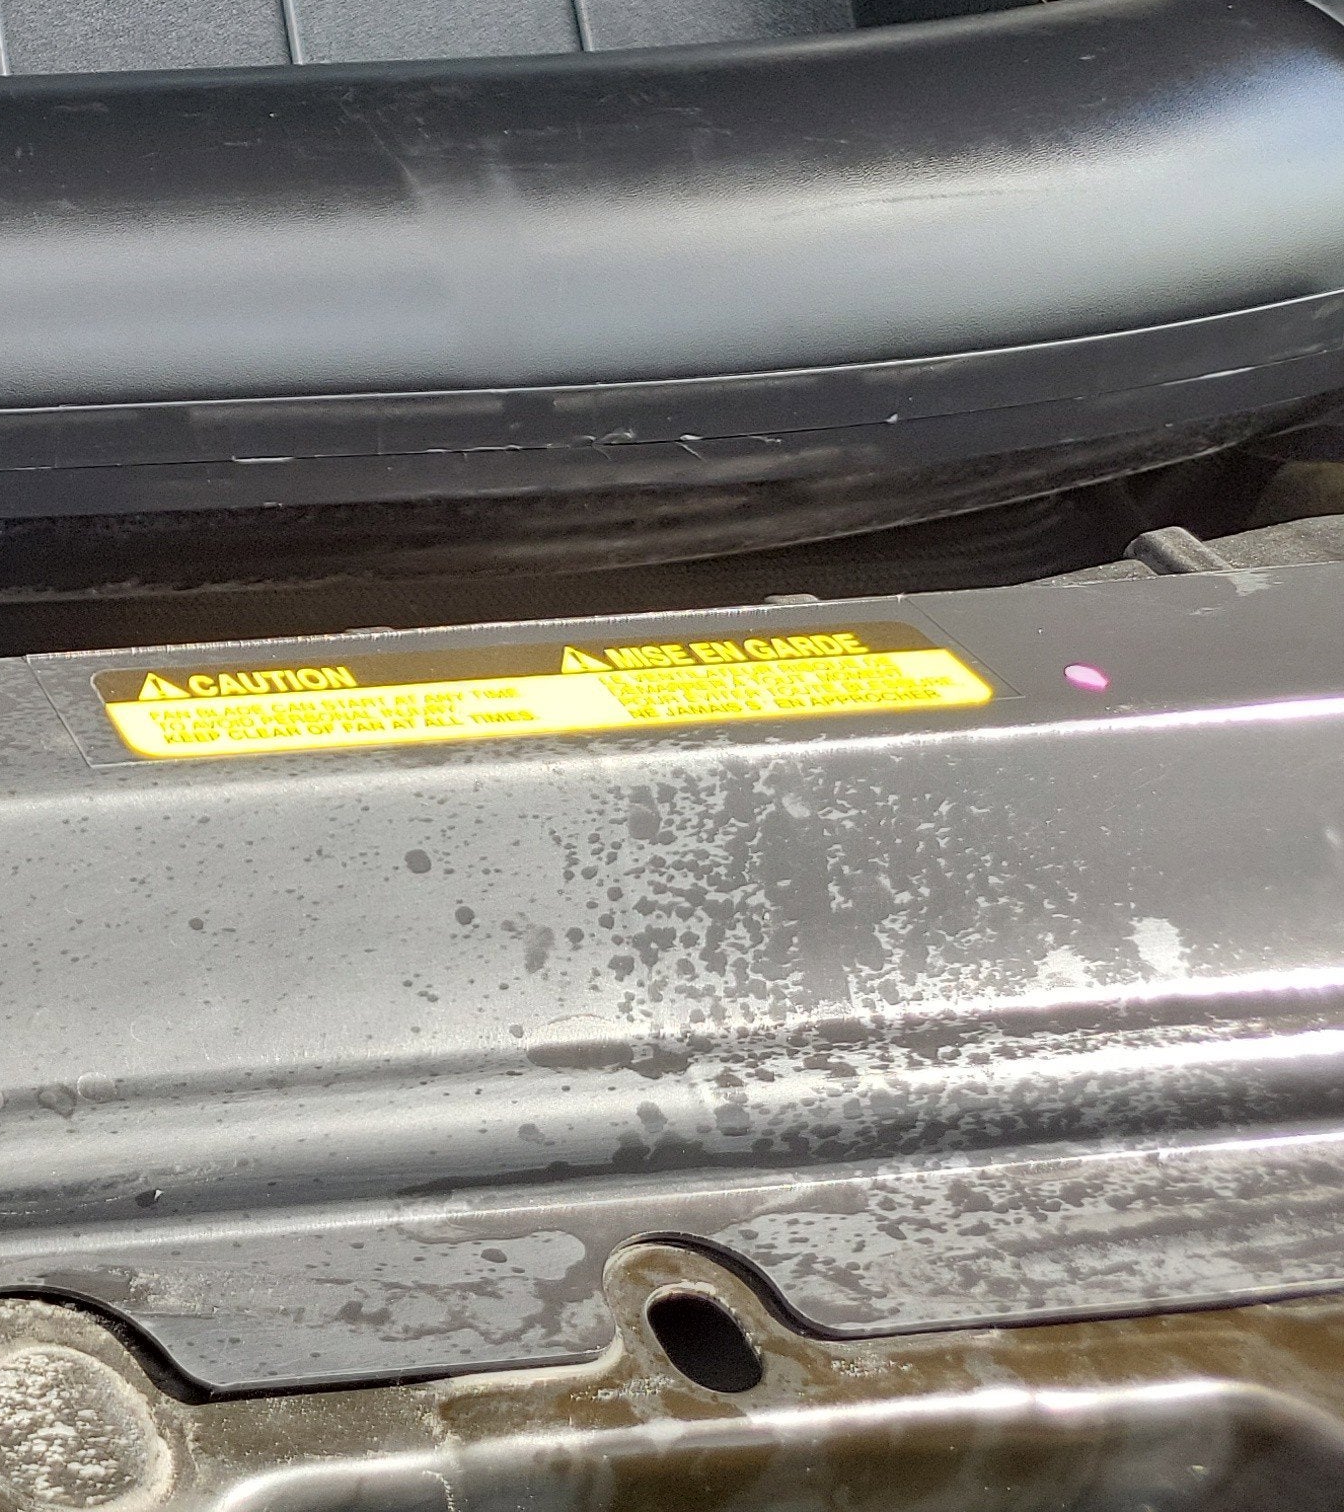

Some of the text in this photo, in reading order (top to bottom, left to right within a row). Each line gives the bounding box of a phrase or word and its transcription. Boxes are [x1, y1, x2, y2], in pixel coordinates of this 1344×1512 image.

[602, 632, 869, 670] MISE EN GARDE
[188, 666, 358, 696] CAUTION
[271, 700, 315, 713] CAN
[470, 687, 519, 700] TIME
[663, 701, 741, 717] JAMAIS
[164, 730, 222, 745] KEEP
[227, 724, 300, 741] CLEAR
[307, 722, 337, 735] OF
[341, 719, 383, 733] FAN
[388, 717, 417, 729] AT
[420, 714, 461, 727] ALL
